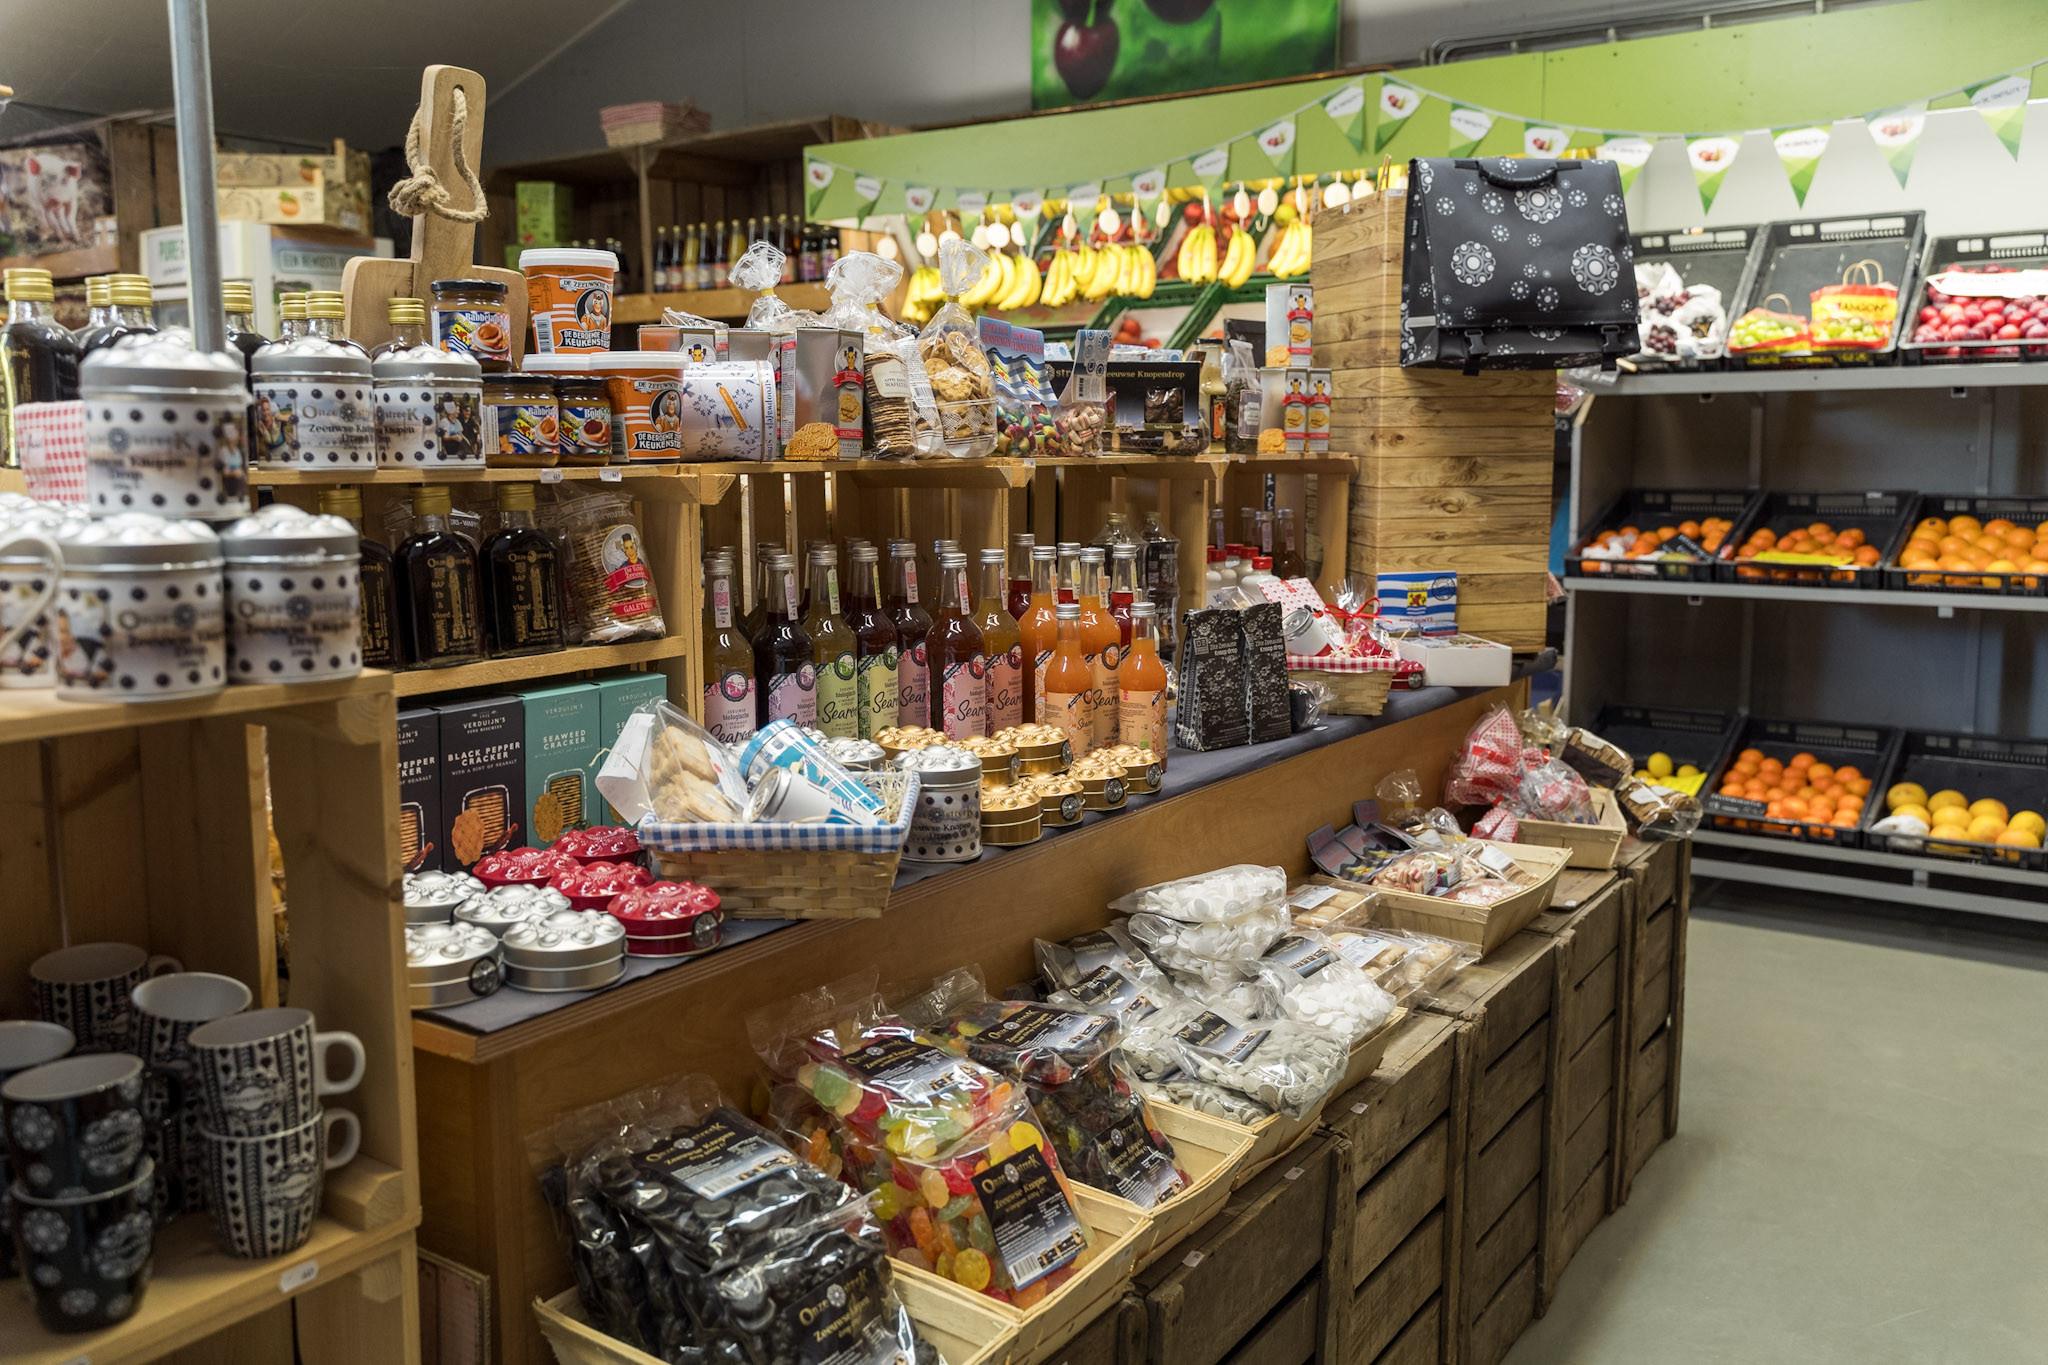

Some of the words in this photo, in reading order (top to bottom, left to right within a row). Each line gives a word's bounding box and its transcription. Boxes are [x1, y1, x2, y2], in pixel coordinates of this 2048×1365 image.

[1106, 370, 1136, 378] eeuwse
[1137, 370, 1185, 380] Knopendrop
[463, 717, 506, 729] VERDUIJN'S
[543, 729, 586, 744] SEAWEED
[543, 737, 586, 751] CRACKER
[447, 749, 481, 762] BLACK
[485, 741, 521, 755] PEPPER
[461, 751, 509, 767] CRACKER
